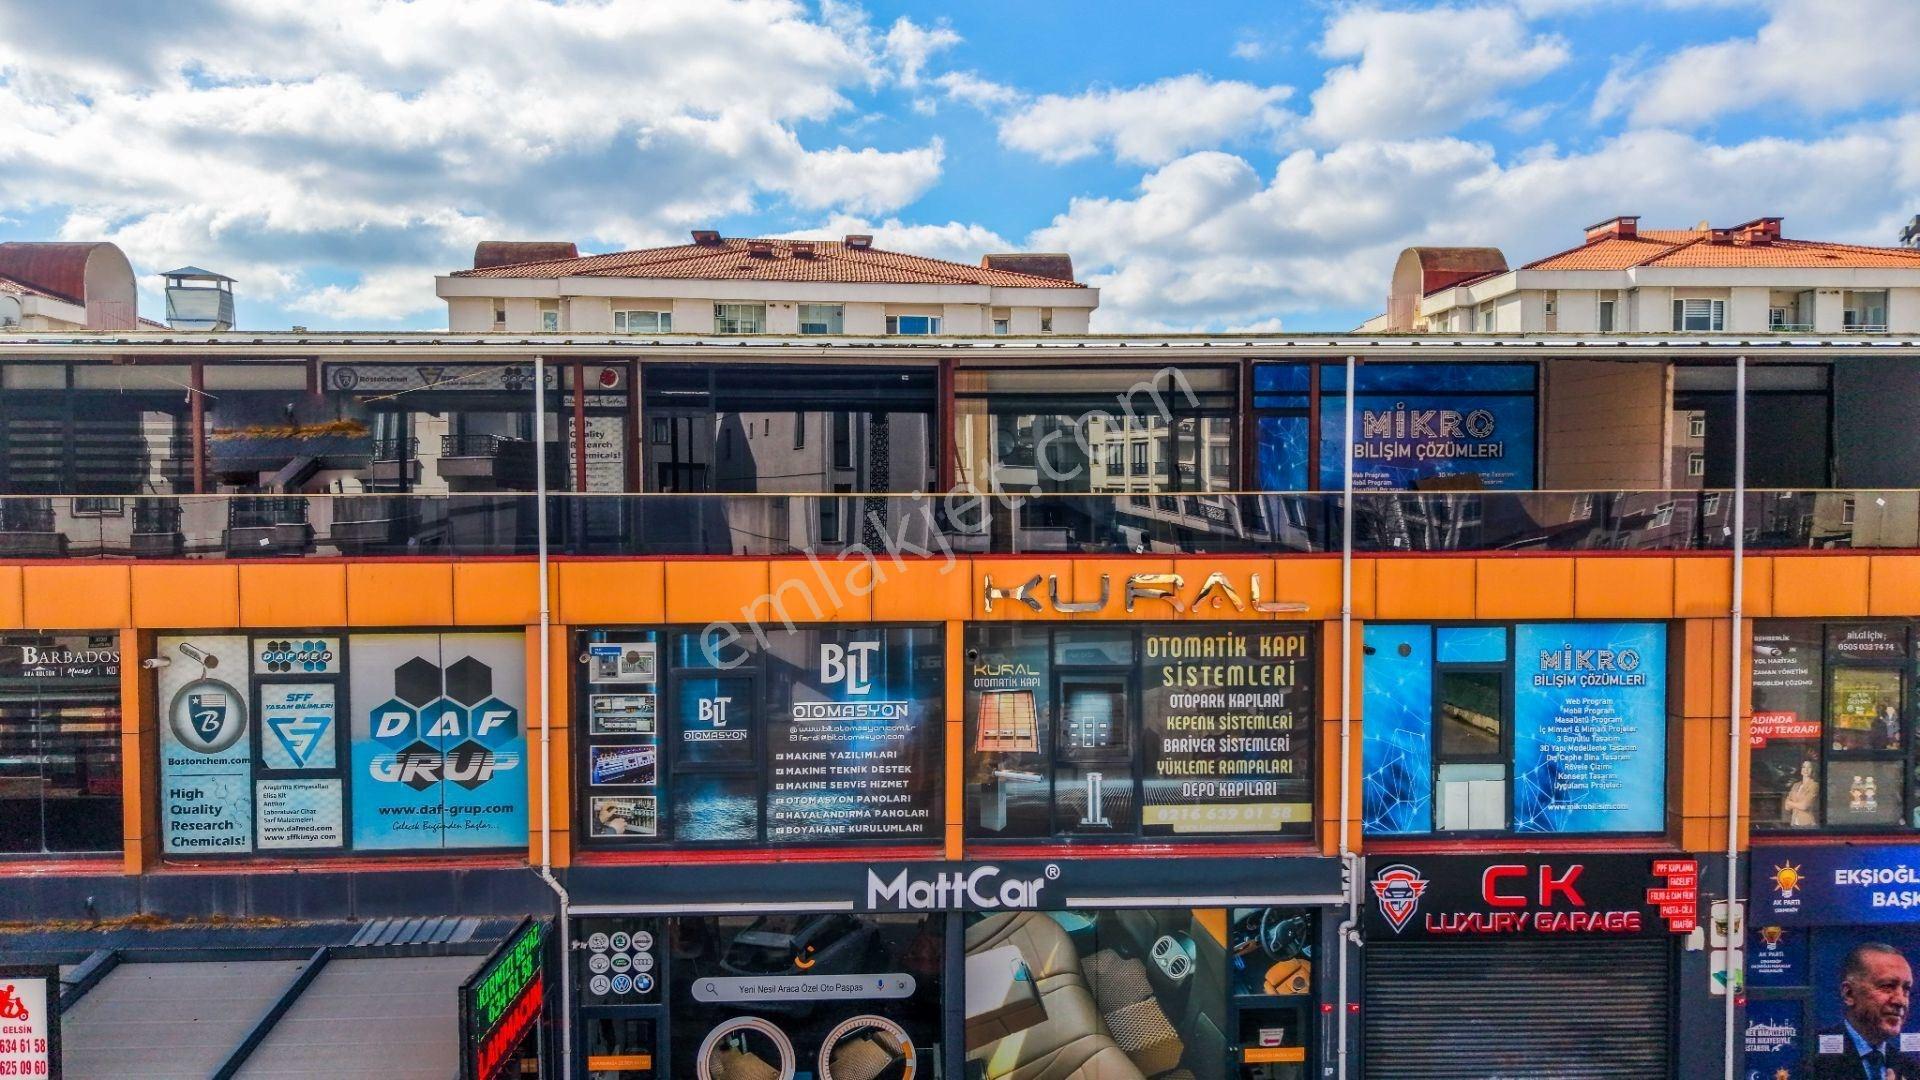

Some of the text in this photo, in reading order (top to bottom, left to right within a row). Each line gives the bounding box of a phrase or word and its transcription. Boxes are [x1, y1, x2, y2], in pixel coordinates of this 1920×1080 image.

[501, 374, 553, 383] DAFMD
[1364, 401, 1495, 438] MİKRO
[1354, 440, 1503, 461] BİLİŞİM ÇÖZÜMLERİ
[984, 571, 1310, 613] KURAL
[1146, 631, 1305, 658] OTOMATİK KAPI
[21, 646, 120, 665] BARBADOS
[262, 652, 332, 661] DAFMED
[1540, 643, 1640, 671] MİKRO
[973, 664, 1040, 676] KURAL
[1162, 659, 1295, 687] SİSTEMLERİ
[974, 676, 1040, 688] OTOMATİK KAPI
[1534, 673, 1645, 688] BİLİŞİM ÇÖZÜMLERİ
[286, 693, 314, 702] SFF
[1169, 693, 1284, 708] OTOPARK KAPILARI
[1582, 698, 1614, 706] Program
[793, 701, 909, 721] OTOMASYON
[1584, 707, 1615, 715] Program
[376, 711, 513, 738] DAF
[1166, 712, 1292, 730] KEPENK SİSTEMLERİ
[1591, 716, 1623, 724] Program
[1751, 715, 1793, 724] ADIMDA
[683, 729, 748, 741] OTOMASYON
[1775, 725, 1818, 734] TEKRARI
[1163, 734, 1290, 753] BARİYER SİSTEMLERİ
[168, 757, 250, 766] Bostonchem.com
[786, 752, 827, 760] MAKİNE
[369, 752, 520, 783] GRUP
[786, 765, 912, 775] MAKİNE TEKNİK DESTEK
[1157, 757, 1292, 775] YÜKLEME RAMPALARI
[786, 780, 910, 790] MAKİNE SERVİS HİZMET
[1182, 781, 1277, 797] DEPO KAPILARI
[169, 788, 204, 800] High
[786, 793, 911, 804] OTOMASYON PANOLARI
[171, 804, 223, 817] Quality
[379, 804, 514, 816] www.daf-grup.com
[786, 809, 929, 819] HAVALANDIRMA PANOLARI
[1158, 806, 1292, 821] 0216 639 01 58
[171, 820, 234, 831] Research
[786, 824, 923, 834] BOYAHANE KURULUMLARI
[171, 835, 246, 847] Chemicals!
[1425, 910, 1641, 933] LUXURY GARAGE
[739, 983, 864, 994] Yeni Nesil Araca Özel Oto Paspas
[3, 1024, 32, 1034] GELSİN
[0, 1038, 46, 1053] 634 61 58
[0, 1060, 46, 1075] 625 09 60
